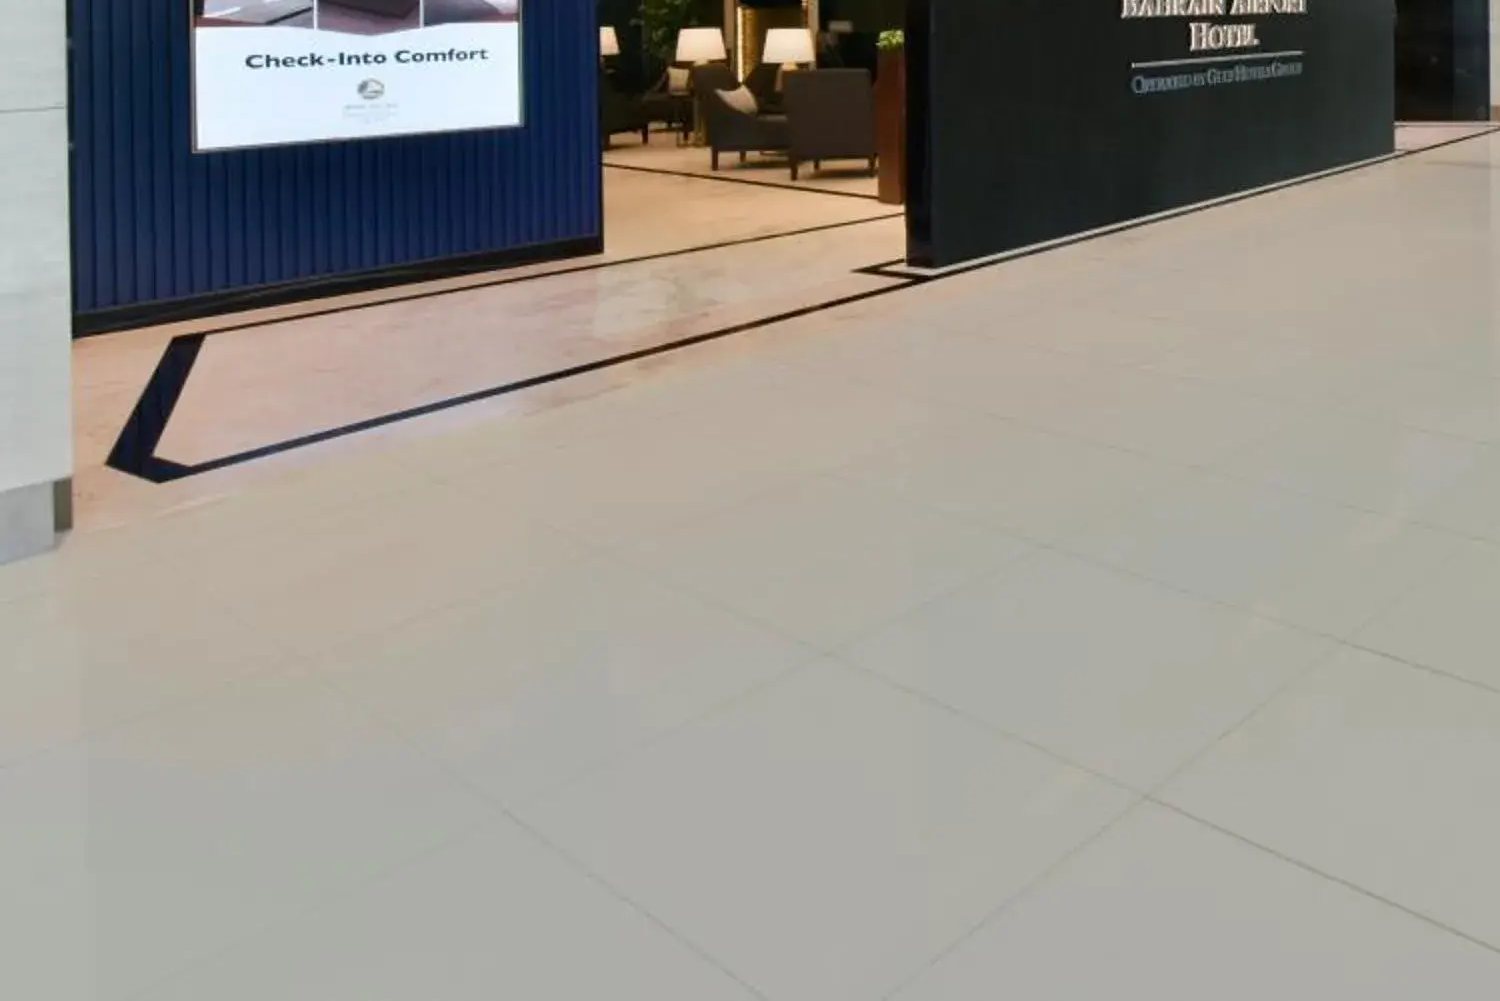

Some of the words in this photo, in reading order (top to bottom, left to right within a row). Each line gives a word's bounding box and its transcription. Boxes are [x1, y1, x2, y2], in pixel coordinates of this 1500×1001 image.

[1189, 22, 1261, 51] HOTEL
[244, 51, 388, 69] Check-Into
[394, 47, 489, 64] Comfort
